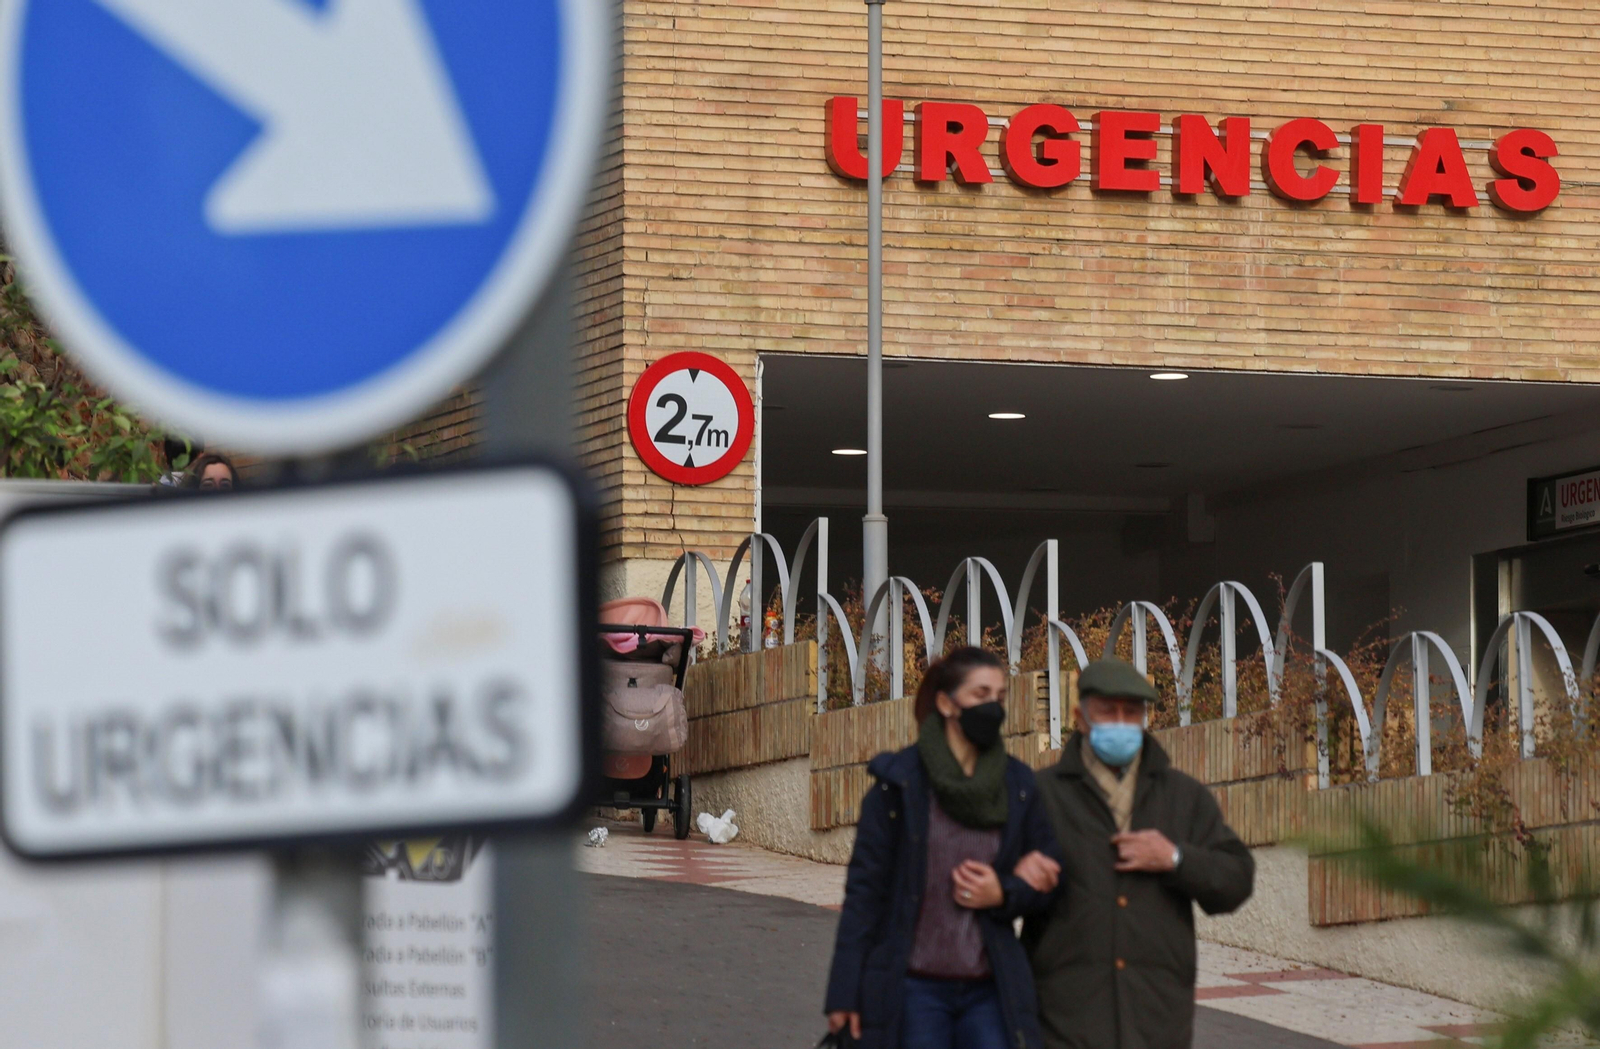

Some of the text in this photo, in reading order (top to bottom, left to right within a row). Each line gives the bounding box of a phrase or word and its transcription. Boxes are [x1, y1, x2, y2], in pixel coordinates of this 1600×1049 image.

[825, 96, 1560, 212] URGENCIAS
[654, 393, 729, 451] 2,7m
[154, 526, 400, 655] SOLO
[29, 672, 533, 818] URGENCIAS
